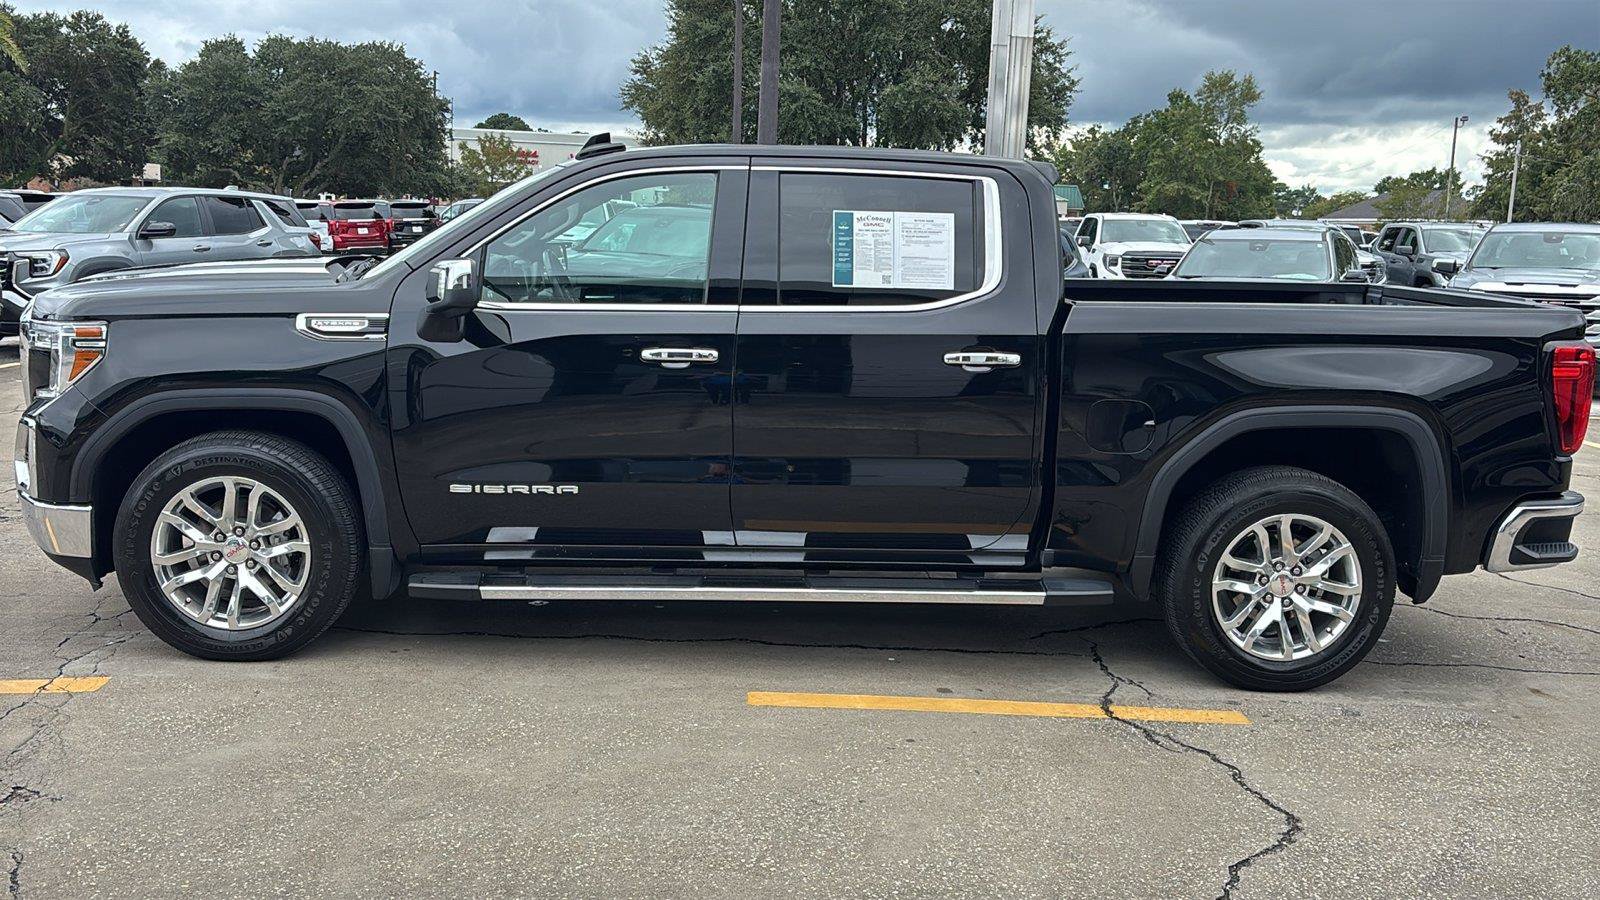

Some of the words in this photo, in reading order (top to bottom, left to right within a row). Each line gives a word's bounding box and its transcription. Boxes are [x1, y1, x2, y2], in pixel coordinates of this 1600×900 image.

[856, 214, 891, 223] McConnell
[194, 456, 263, 468] DESTINATION
[449, 484, 579, 494] SIERRA
[226, 543, 247, 558] GMC
